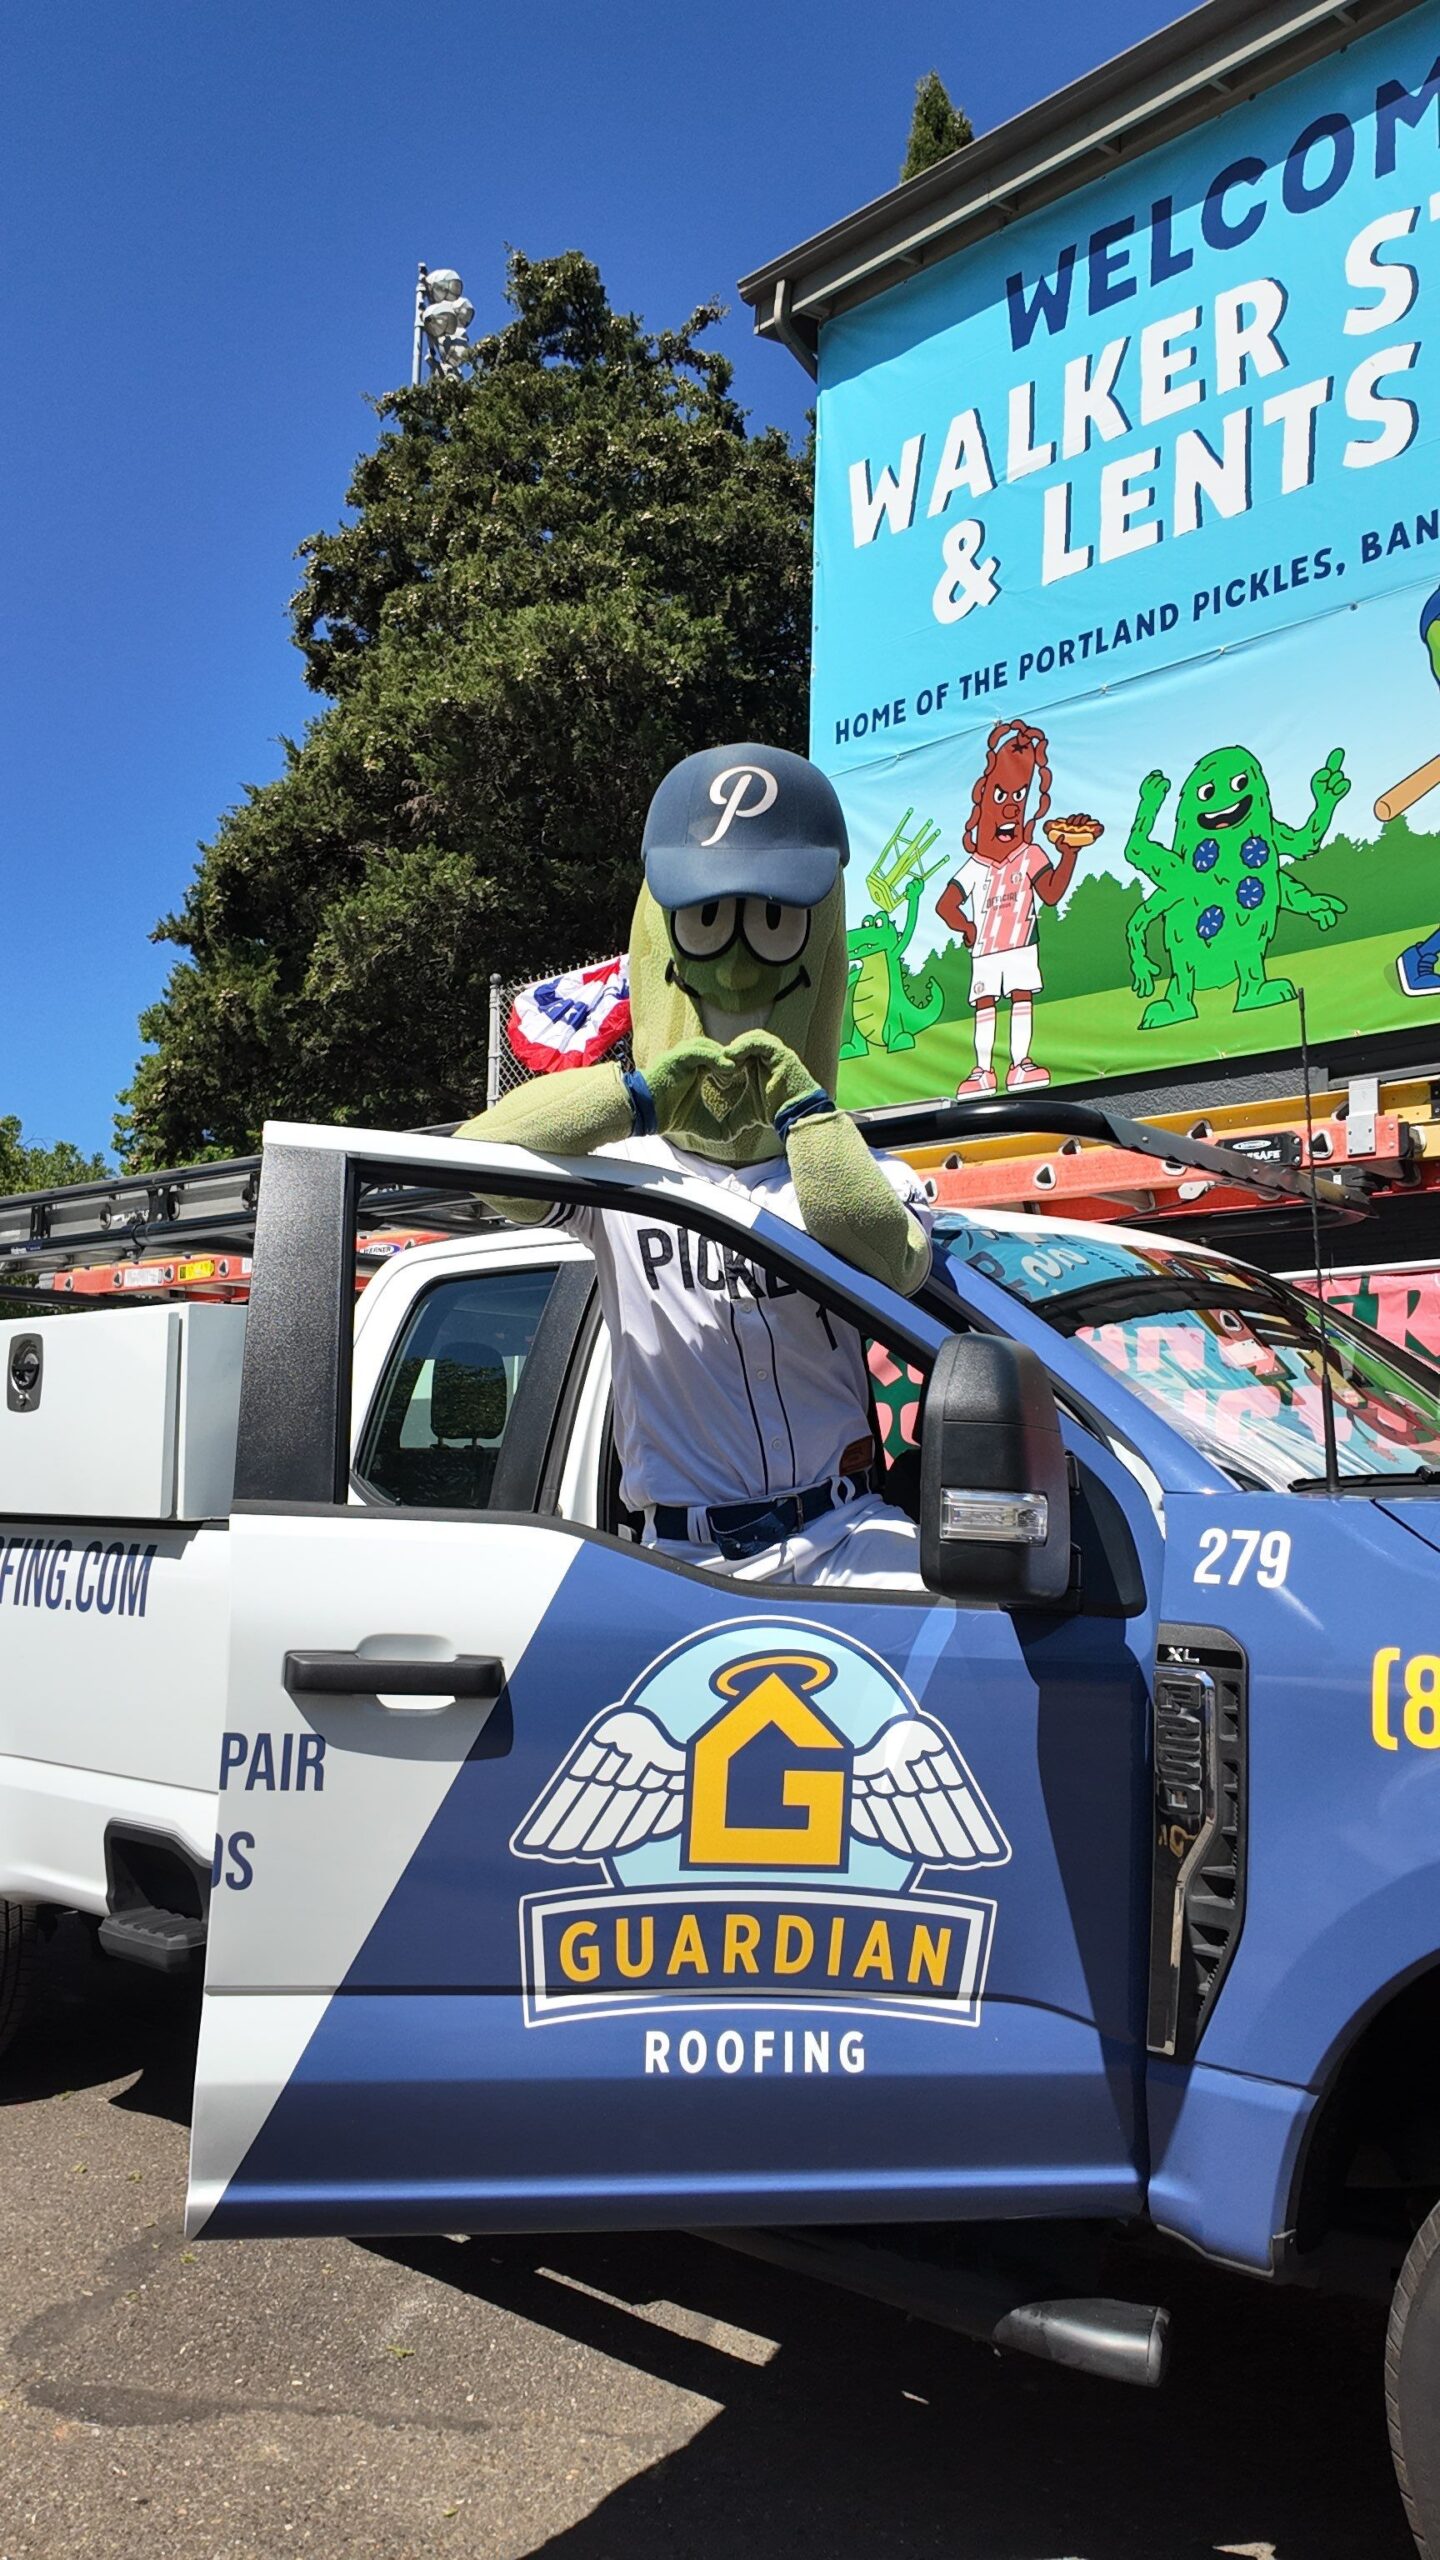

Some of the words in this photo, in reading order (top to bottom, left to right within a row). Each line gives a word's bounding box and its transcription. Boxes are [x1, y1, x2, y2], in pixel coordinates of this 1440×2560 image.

[848, 277, 1289, 548] WALKER
[1345, 190, 1440, 336] S
[931, 519, 1002, 625] &
[1041, 342, 1421, 587] LENTS
[835, 700, 906, 745] HOME
[915, 683, 949, 717] OF
[959, 663, 1008, 707] THE
[1019, 602, 1178, 682] PORTLAND
[1194, 547, 1345, 621] PICKLES,
[1361, 508, 1440, 565] BAN
[702, 765, 778, 847] P
[0, 1536, 158, 1617] FING.COM
[1194, 1528, 1292, 1588] 279
[1166, 1646, 1201, 1664] XL
[219, 1732, 326, 1791] PAIR
[559, 1914, 952, 1987] GUARDIAN
[644, 2030, 866, 2075] ROOFING
